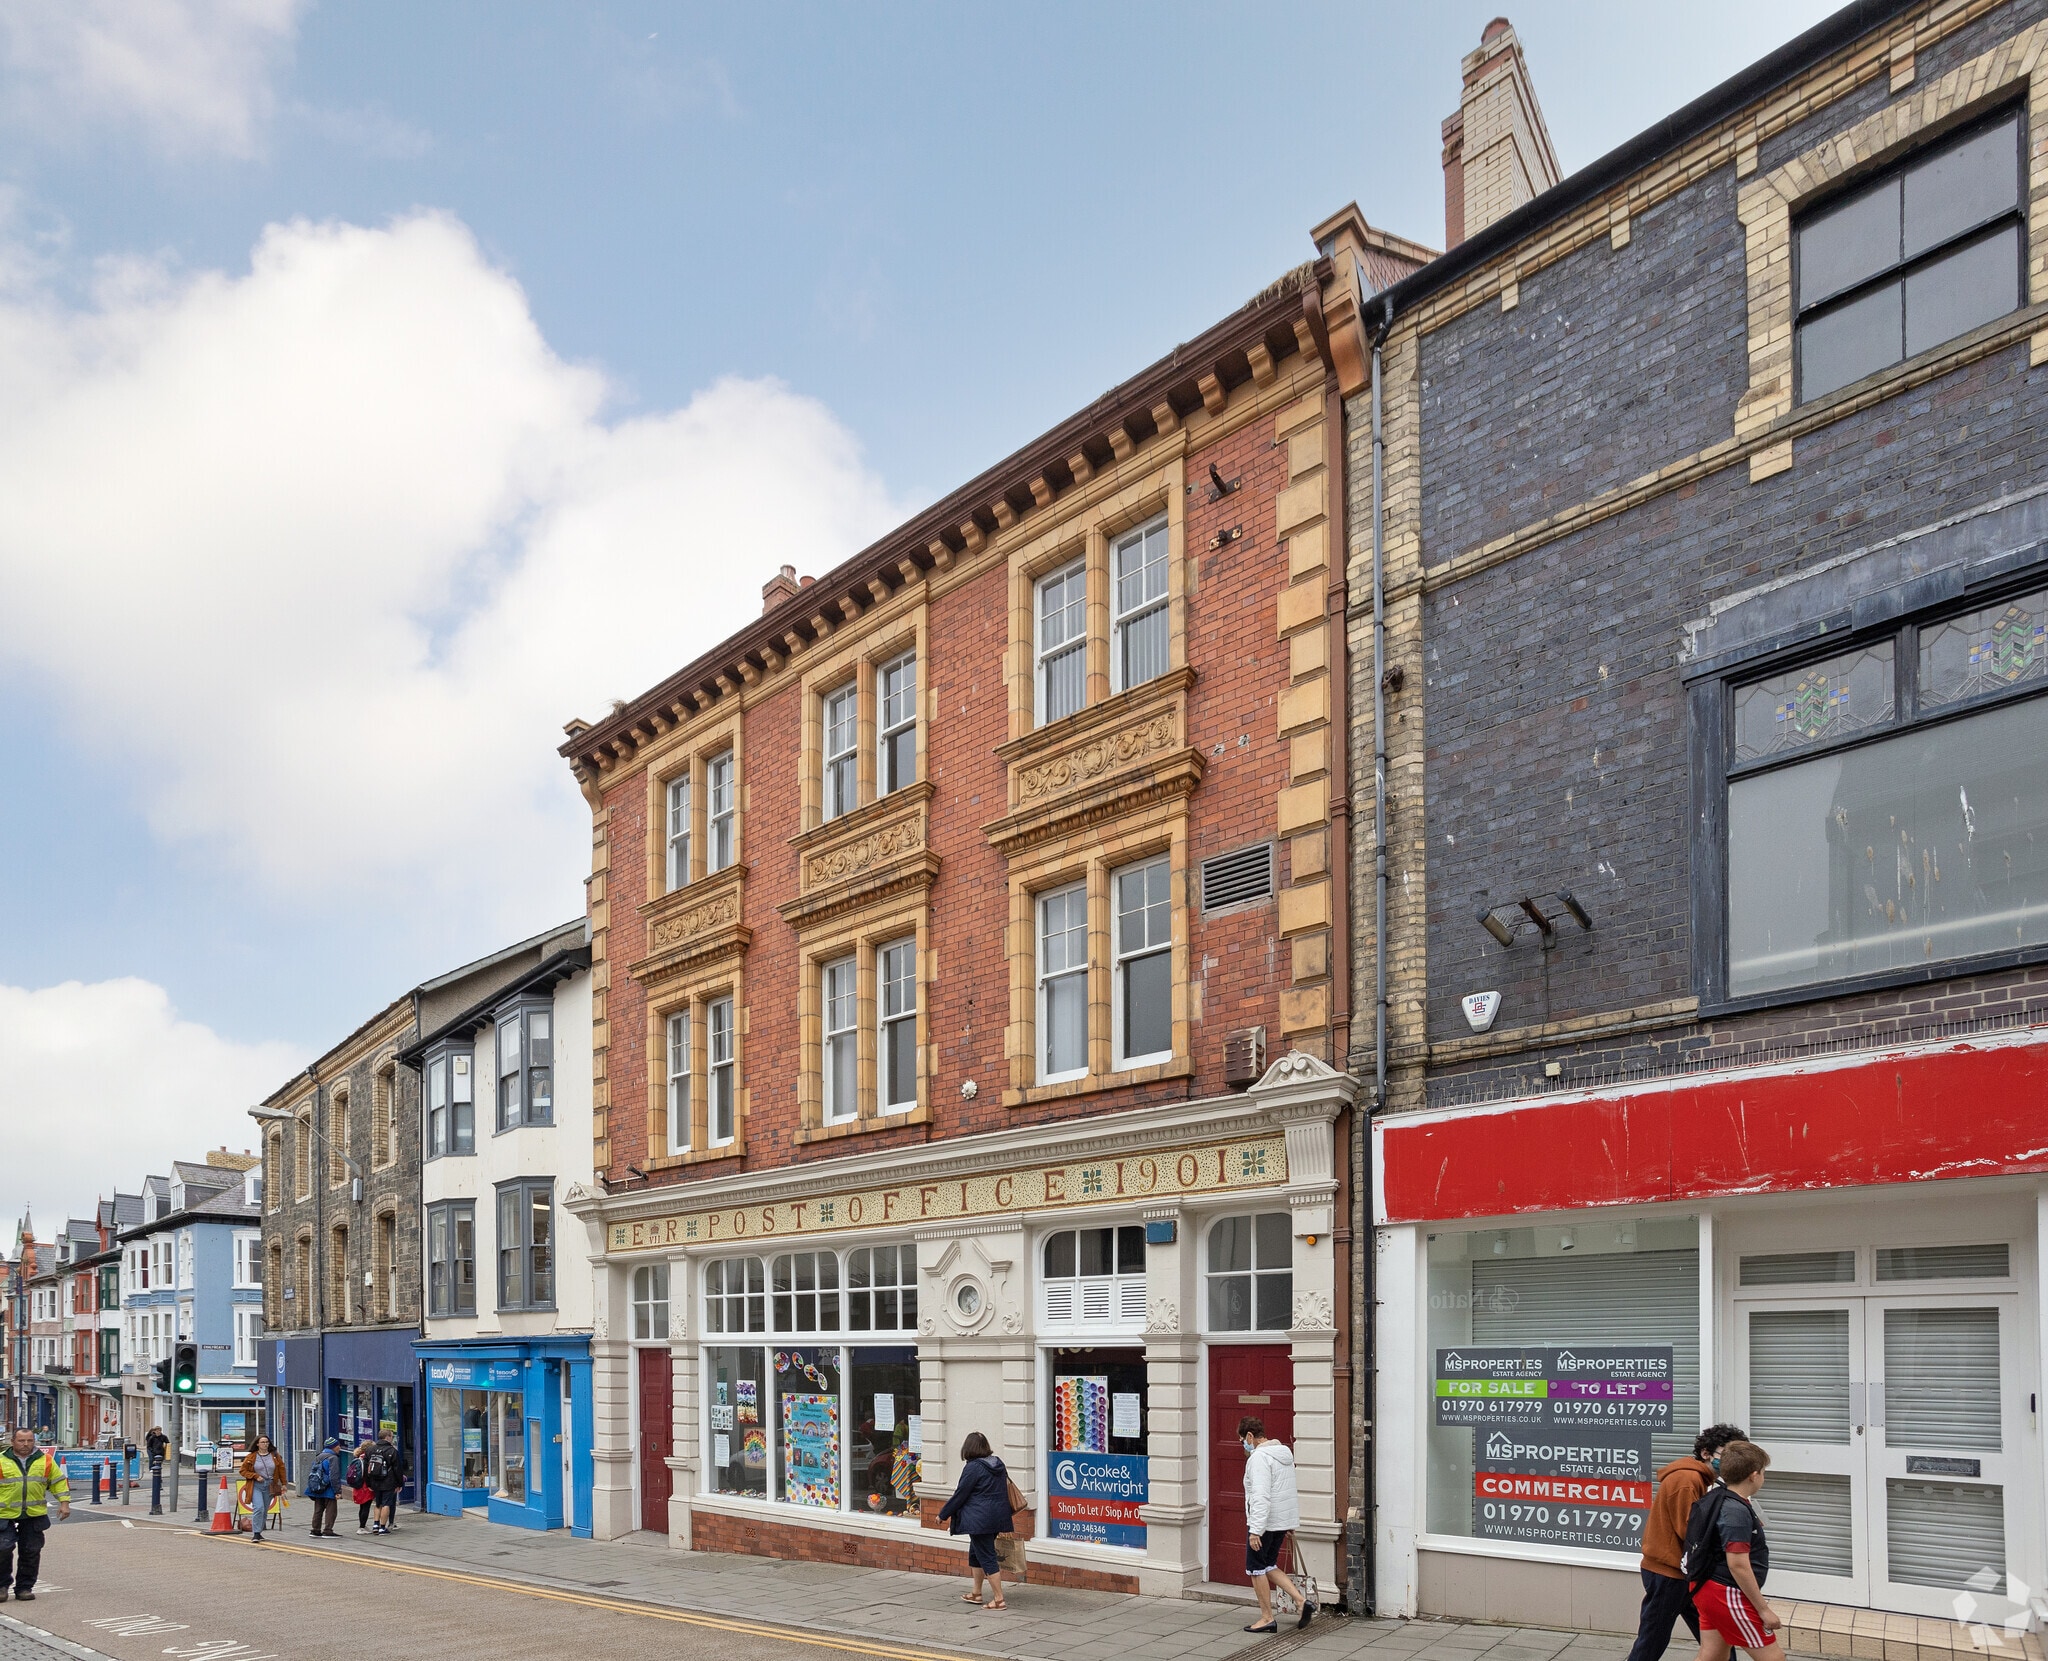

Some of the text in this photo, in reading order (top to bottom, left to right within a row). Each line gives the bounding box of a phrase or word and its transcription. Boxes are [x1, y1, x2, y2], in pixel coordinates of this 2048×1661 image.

[1468, 995, 1490, 1004] DAVIES
[632, 1149, 1228, 1246] E VII R POST OFFICE 1901
[1445, 1359, 1543, 1371] MSPROPERTIES
[1557, 1358, 1668, 1371] MSPROPERTIES
[1449, 1382, 1535, 1394] FOR SALE
[1578, 1384, 1640, 1395] TO LET
[1442, 1400, 1543, 1413] 01970 617979
[1553, 1402, 1668, 1416] 01970 617979
[1441, 1414, 1542, 1423] WWW.MSPROPERTIES.CO.UK
[1553, 1417, 1667, 1427] WWW.MSPROPERTIES.CO.UK
[1486, 1443, 1640, 1464] MSPROPERTIES
[1560, 1464, 1639, 1476] ESTATE AGENCY
[1081, 1478, 1144, 1497] Arkwright
[1482, 1478, 1644, 1503] COMMERCIAL
[1058, 1502, 1077, 1516] Shop
[1077, 1503, 1086, 1515] To
[1087, 1504, 1099, 1516] Let
[1105, 1506, 1122, 1520] Siop
[1124, 1507, 1132, 1519] Ar
[1483, 1503, 1642, 1531] 01970 617979
[1059, 1522, 1071, 1531] 029
[1072, 1523, 1081, 1531] 20
[1484, 1524, 1642, 1547] WWW.MSPROPERTIES.CO.UK
[82, 1613, 190, 1637] ONLY
